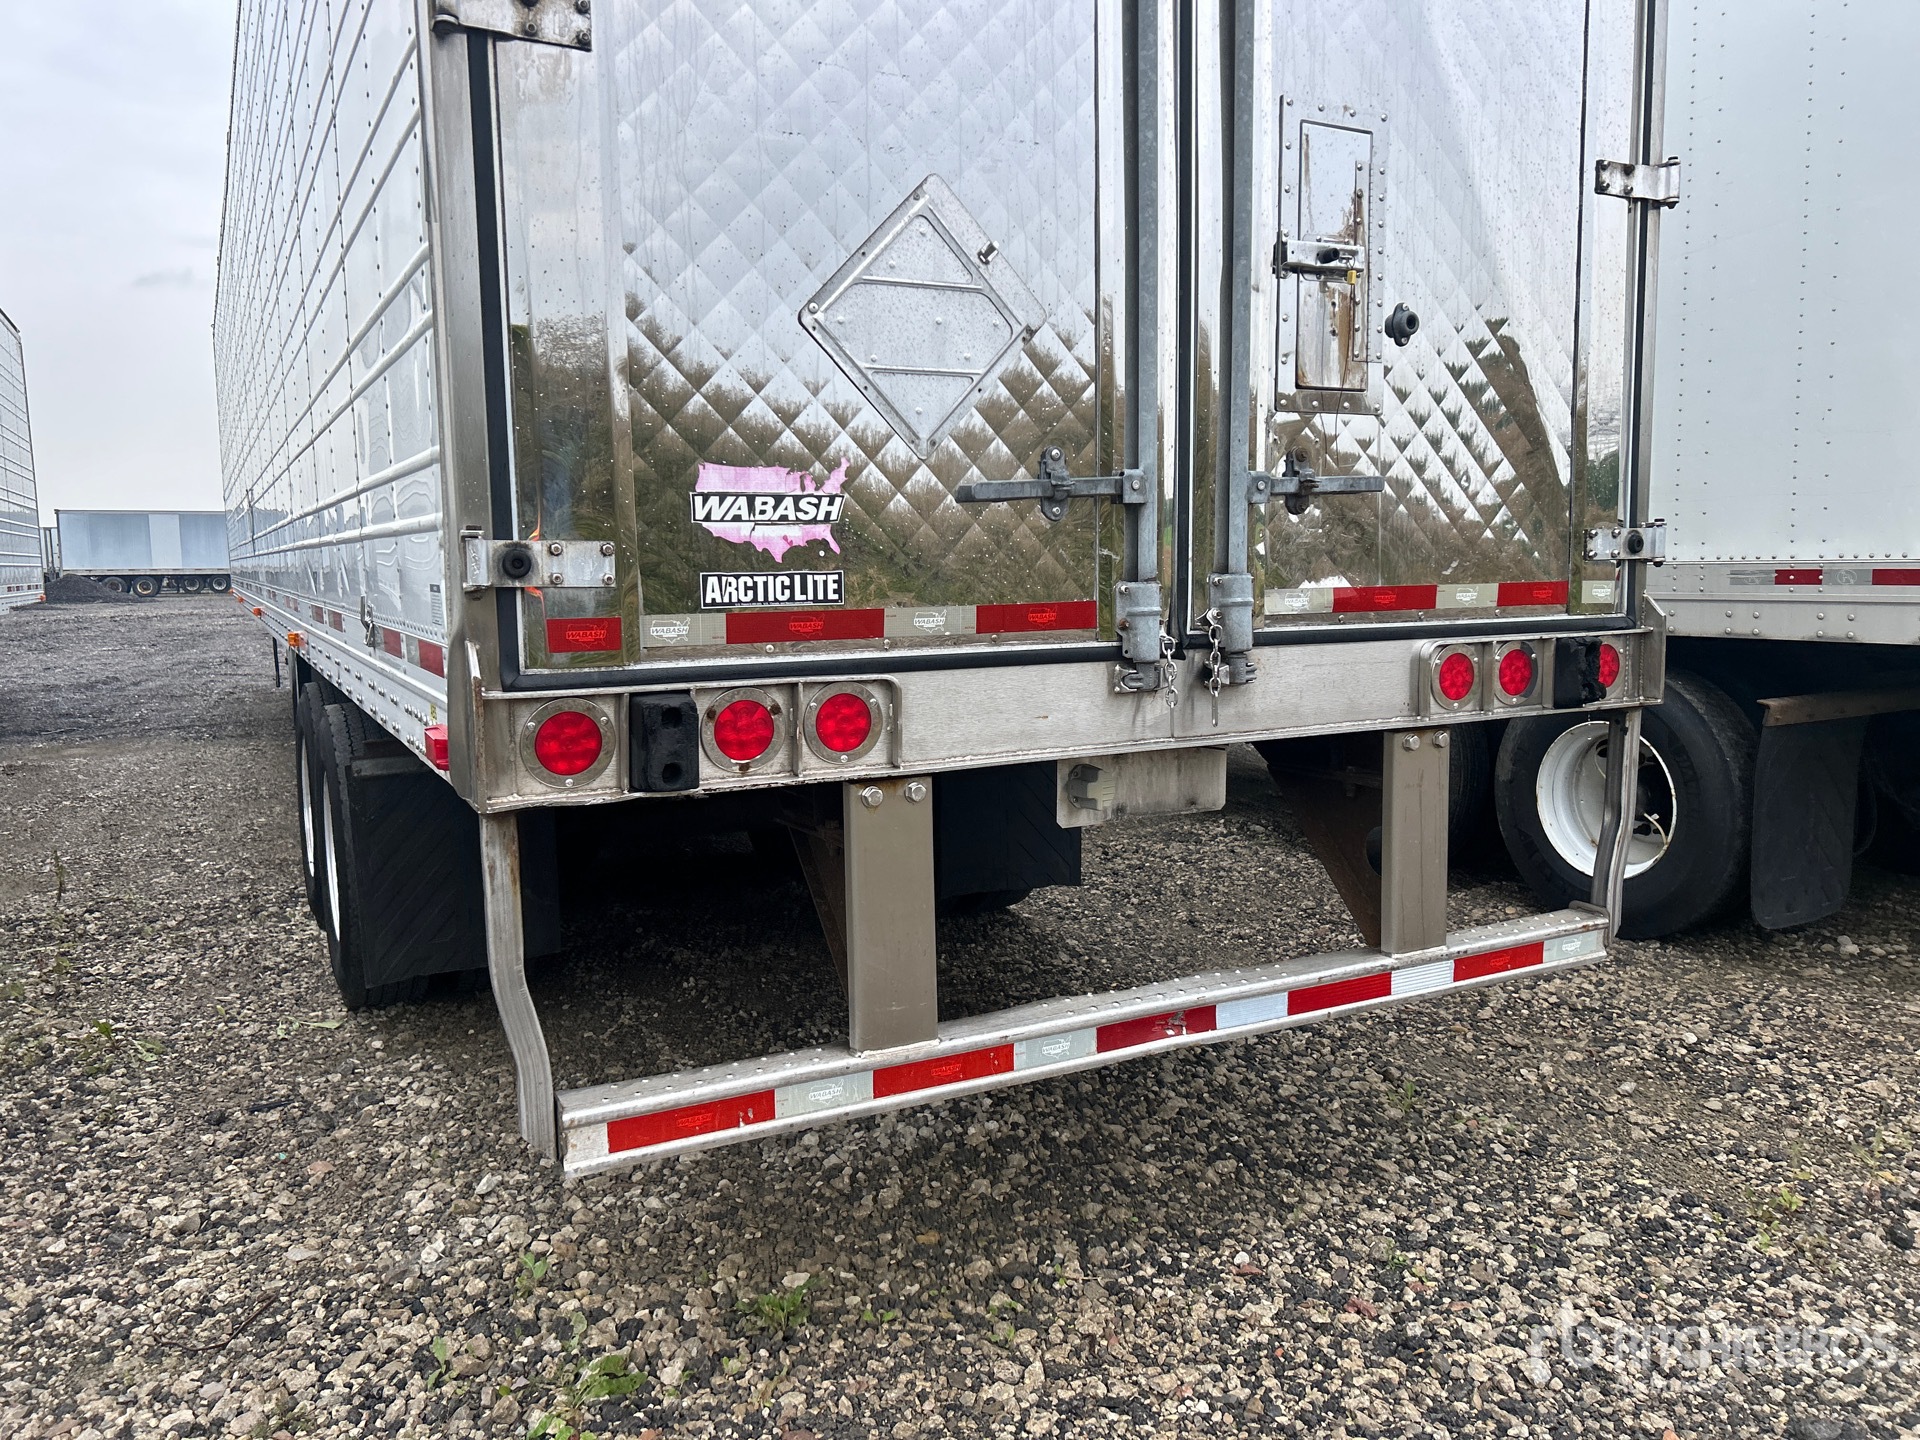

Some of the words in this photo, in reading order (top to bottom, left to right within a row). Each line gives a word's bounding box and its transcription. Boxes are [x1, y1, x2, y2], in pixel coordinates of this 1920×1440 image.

[695, 496, 843, 521] WABASH
[705, 576, 790, 603] ARCTIC
[794, 575, 839, 600] LITE
[1028, 613, 1056, 621] WABASH
[651, 627, 689, 635] WABASH
[789, 622, 823, 630] WABASH
[567, 630, 606, 639] WABASH
[1042, 1043, 1071, 1053] WABASH
[809, 1087, 842, 1099] WABASH
[677, 1113, 713, 1126] WABASH
